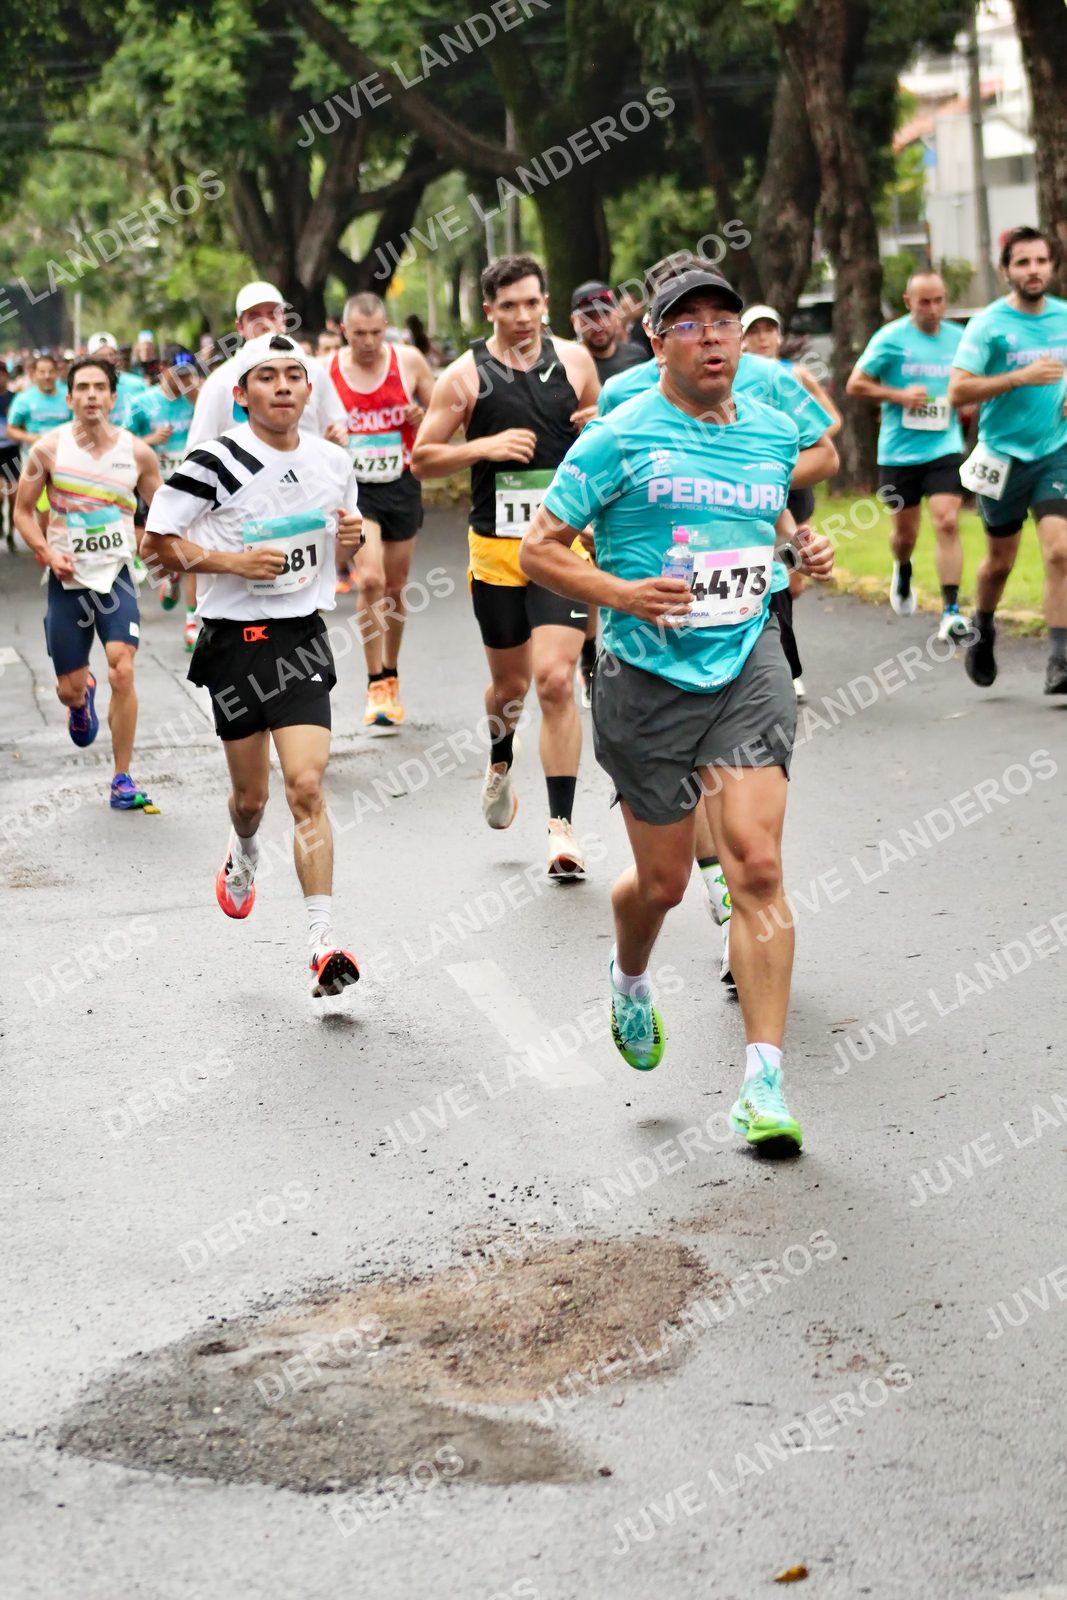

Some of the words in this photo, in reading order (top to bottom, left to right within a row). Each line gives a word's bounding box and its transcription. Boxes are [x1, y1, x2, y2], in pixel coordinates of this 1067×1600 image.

[353, 455, 399, 471] 4737
[504, 503, 541, 522] 11
[72, 532, 123, 553] 2608
[691, 565, 767, 602] 4473
